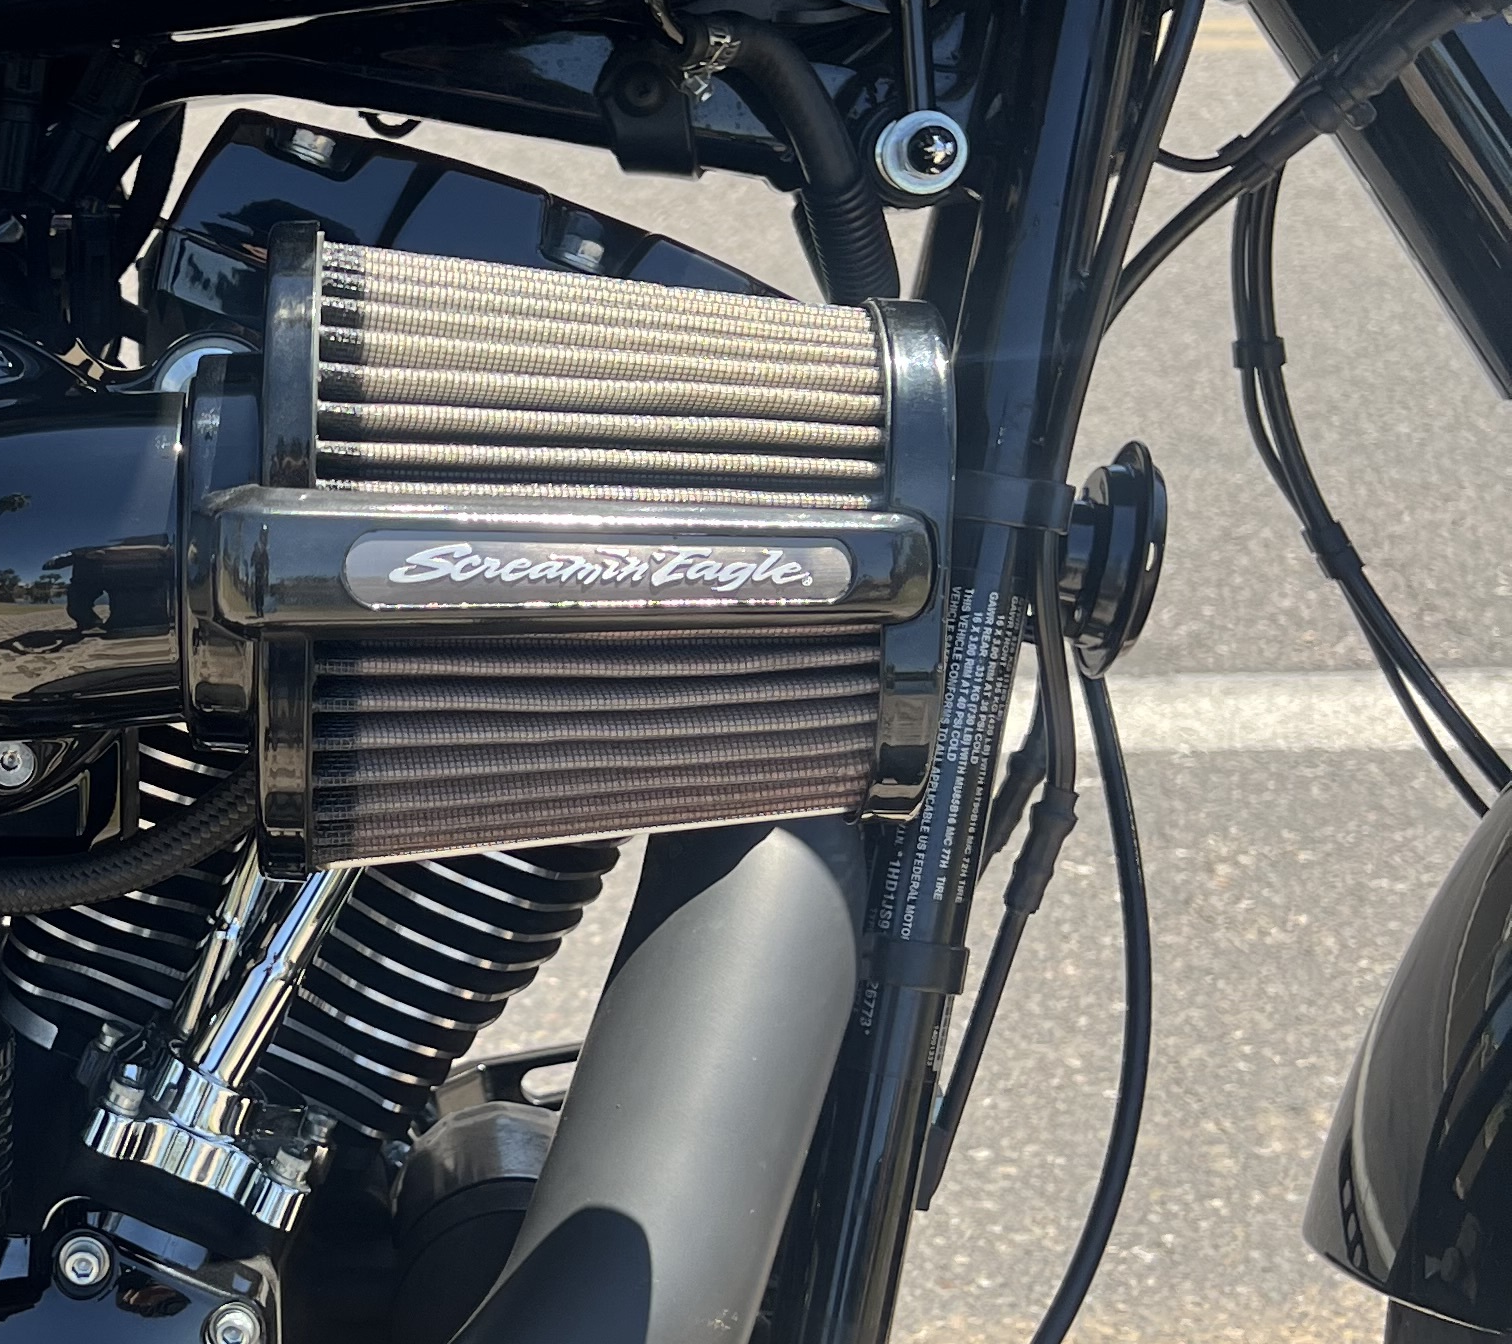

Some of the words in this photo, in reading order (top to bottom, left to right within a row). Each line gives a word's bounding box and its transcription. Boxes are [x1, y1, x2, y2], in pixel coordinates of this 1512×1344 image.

[961, 588, 974, 612] THIS
[985, 591, 999, 625] GAWR
[972, 611, 983, 624] 16
[1007, 596, 1018, 628] GAWR
[952, 614, 970, 661] VEHICLE
[966, 634, 979, 657] 3.00
[979, 626, 992, 657] REAR
[999, 631, 1012, 667] FRONT
[962, 658, 975, 678] RIM
[974, 665, 985, 682] 331
[940, 662, 960, 725] CONFORMS
[959, 680, 971, 695] AT
[970, 685, 981, 702] KG
[983, 683, 993, 697] AT
[956, 696, 967, 709] 40
[953, 711, 964, 729] PSI
[964, 703, 978, 726] (730
[976, 714, 987, 732] PSI
[936, 727, 948, 742] TO
[946, 730, 961, 762] COLD
[960, 727, 974, 746] LB)
[934, 744, 945, 762] ALL
[970, 733, 983, 765] COLD
[956, 747, 969, 775] WITH
[919, 766, 941, 834] APPLICABLE
[916, 835, 928, 851] US
[938, 847, 951, 869] 77H
[906, 852, 925, 903] FEDERAL
[932, 875, 946, 901] TIRE
